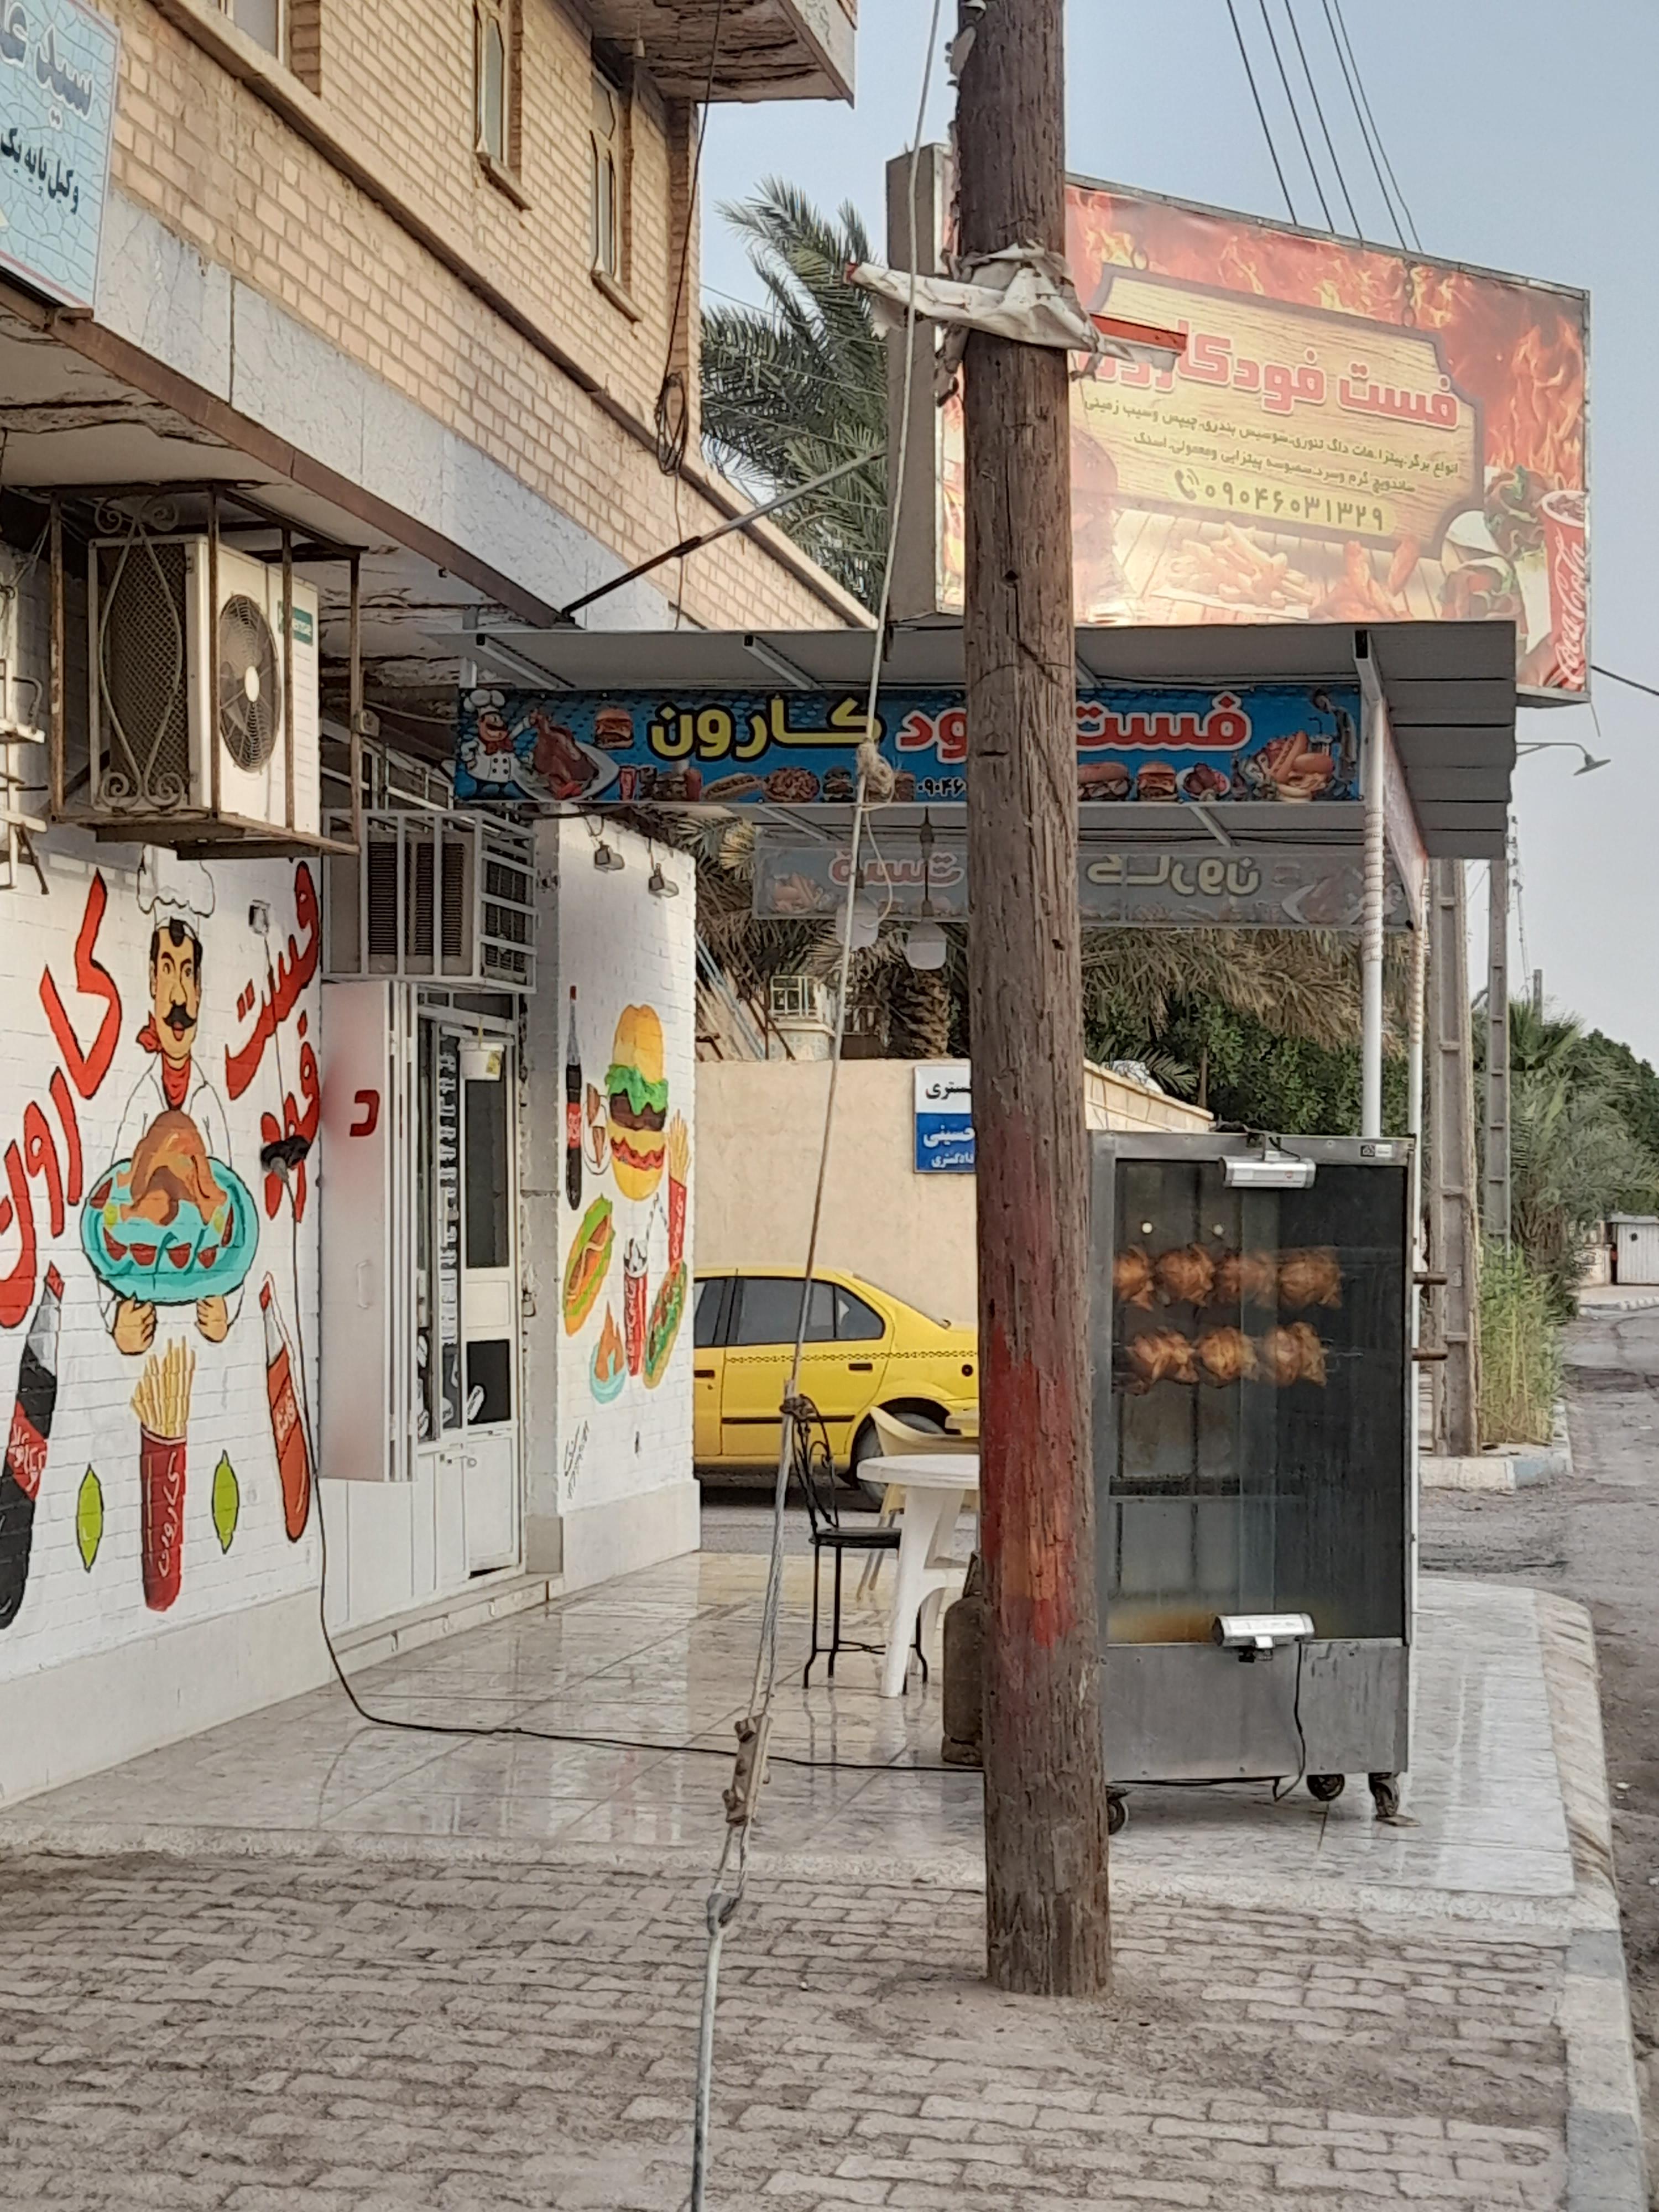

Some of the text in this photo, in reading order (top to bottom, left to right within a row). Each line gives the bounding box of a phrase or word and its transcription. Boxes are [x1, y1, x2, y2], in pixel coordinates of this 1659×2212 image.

[24, 146, 47, 194] پایه
[48, 159, 79, 215] وکیل
[1084, 398, 1119, 415] زمینی
[1338, 363, 1458, 428] فست
[1328, 439, 1349, 453] داگ
[1266, 458, 1312, 474] سمبوسه
[1349, 471, 1369, 487] گرم
[1432, 457, 1458, 478] انواع
[1373, 477, 1416, 494] ساندویچ
[649, 693, 1250, 762] فست ود کارون
[225, 860, 320, 1102] فست
[0, 867, 123, 1328] کارون
[922, 1124, 975, 1148] حسینی
[158, 1451, 180, 1578] کارون
